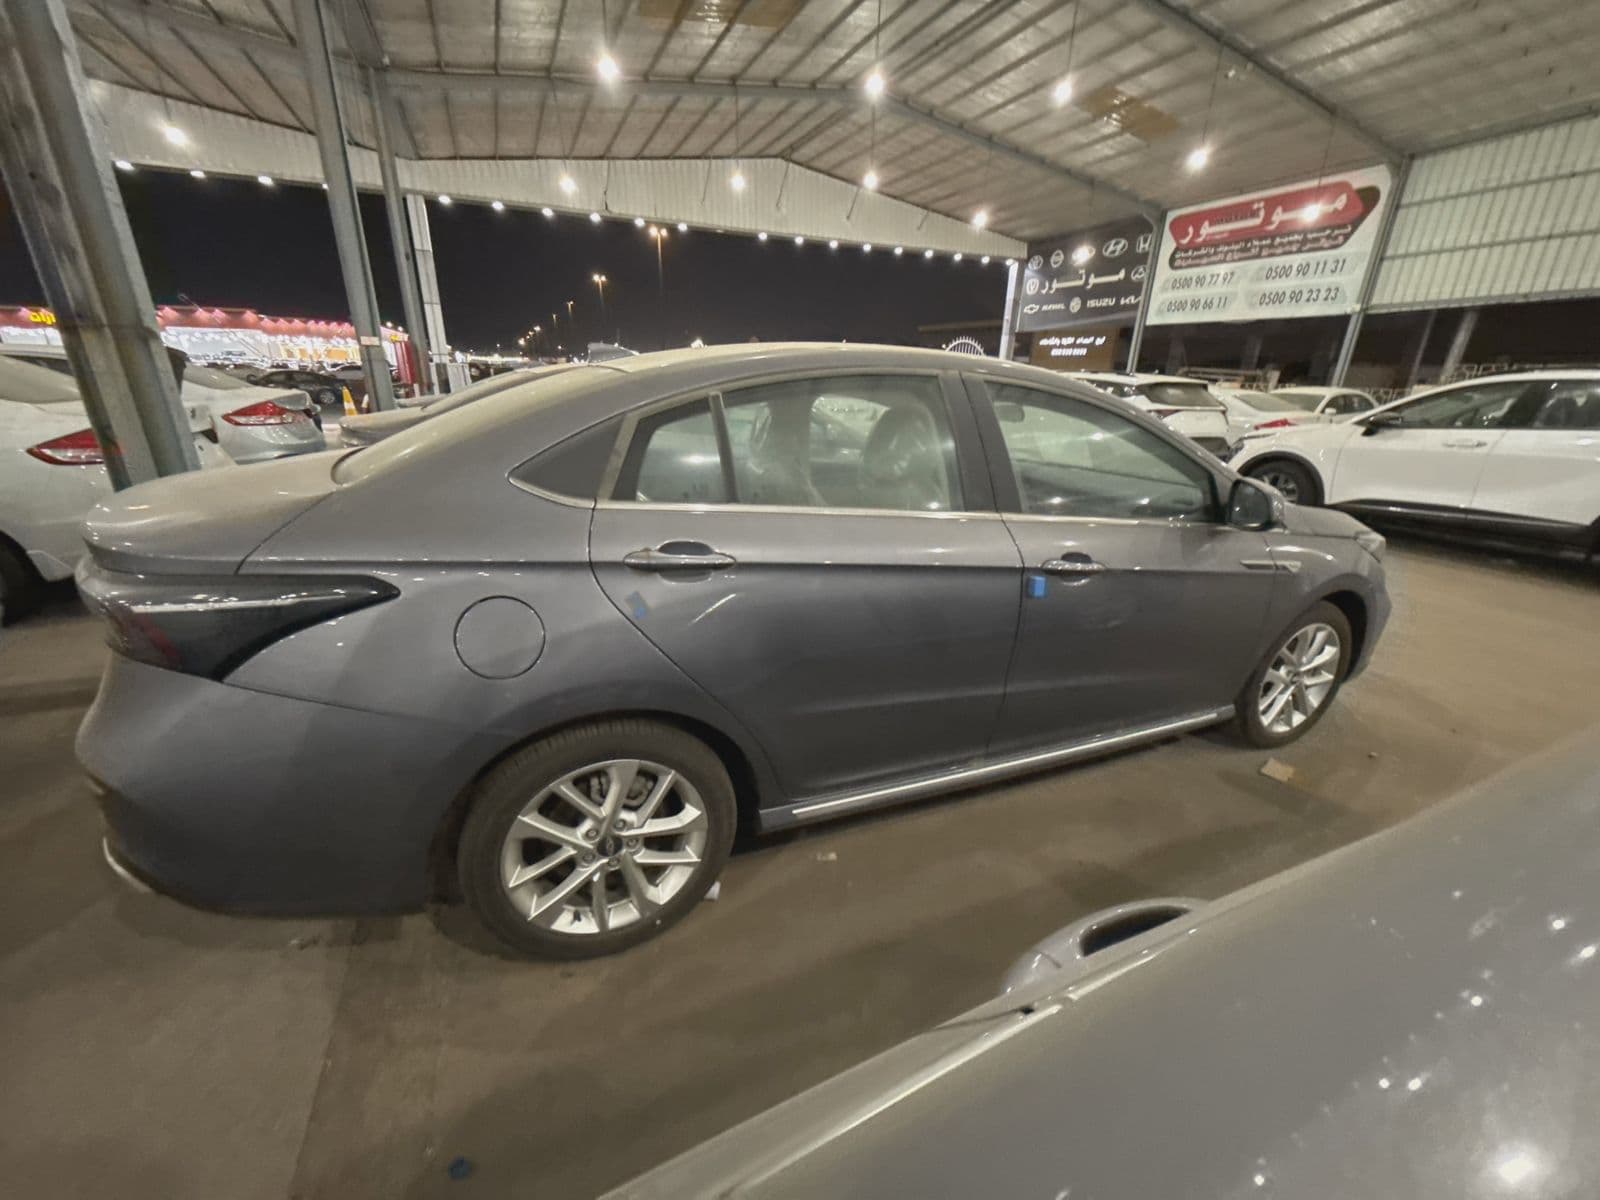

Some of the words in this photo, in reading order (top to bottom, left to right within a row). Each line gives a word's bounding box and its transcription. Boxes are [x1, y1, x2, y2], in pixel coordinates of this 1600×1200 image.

[1265, 265, 1293, 281] 0500
[1296, 263, 1311, 277] 90
[1313, 261, 1328, 275] 11
[1330, 258, 1347, 273] 31
[1171, 276, 1193, 290] 0500
[1194, 275, 1206, 287] 90
[1208, 273, 1221, 286] 77
[1086, 296, 1116, 309] ISUZU
[1166, 299, 1187, 313] 0500
[1189, 298, 1201, 311] 90
[1202, 297, 1214, 310] 66
[1216, 296, 1228, 309] 11
[1258, 292, 1286, 307] 0500
[1288, 290, 1302, 305] 90
[1306, 288, 1320, 302] 23
[1323, 287, 1340, 302] 23
